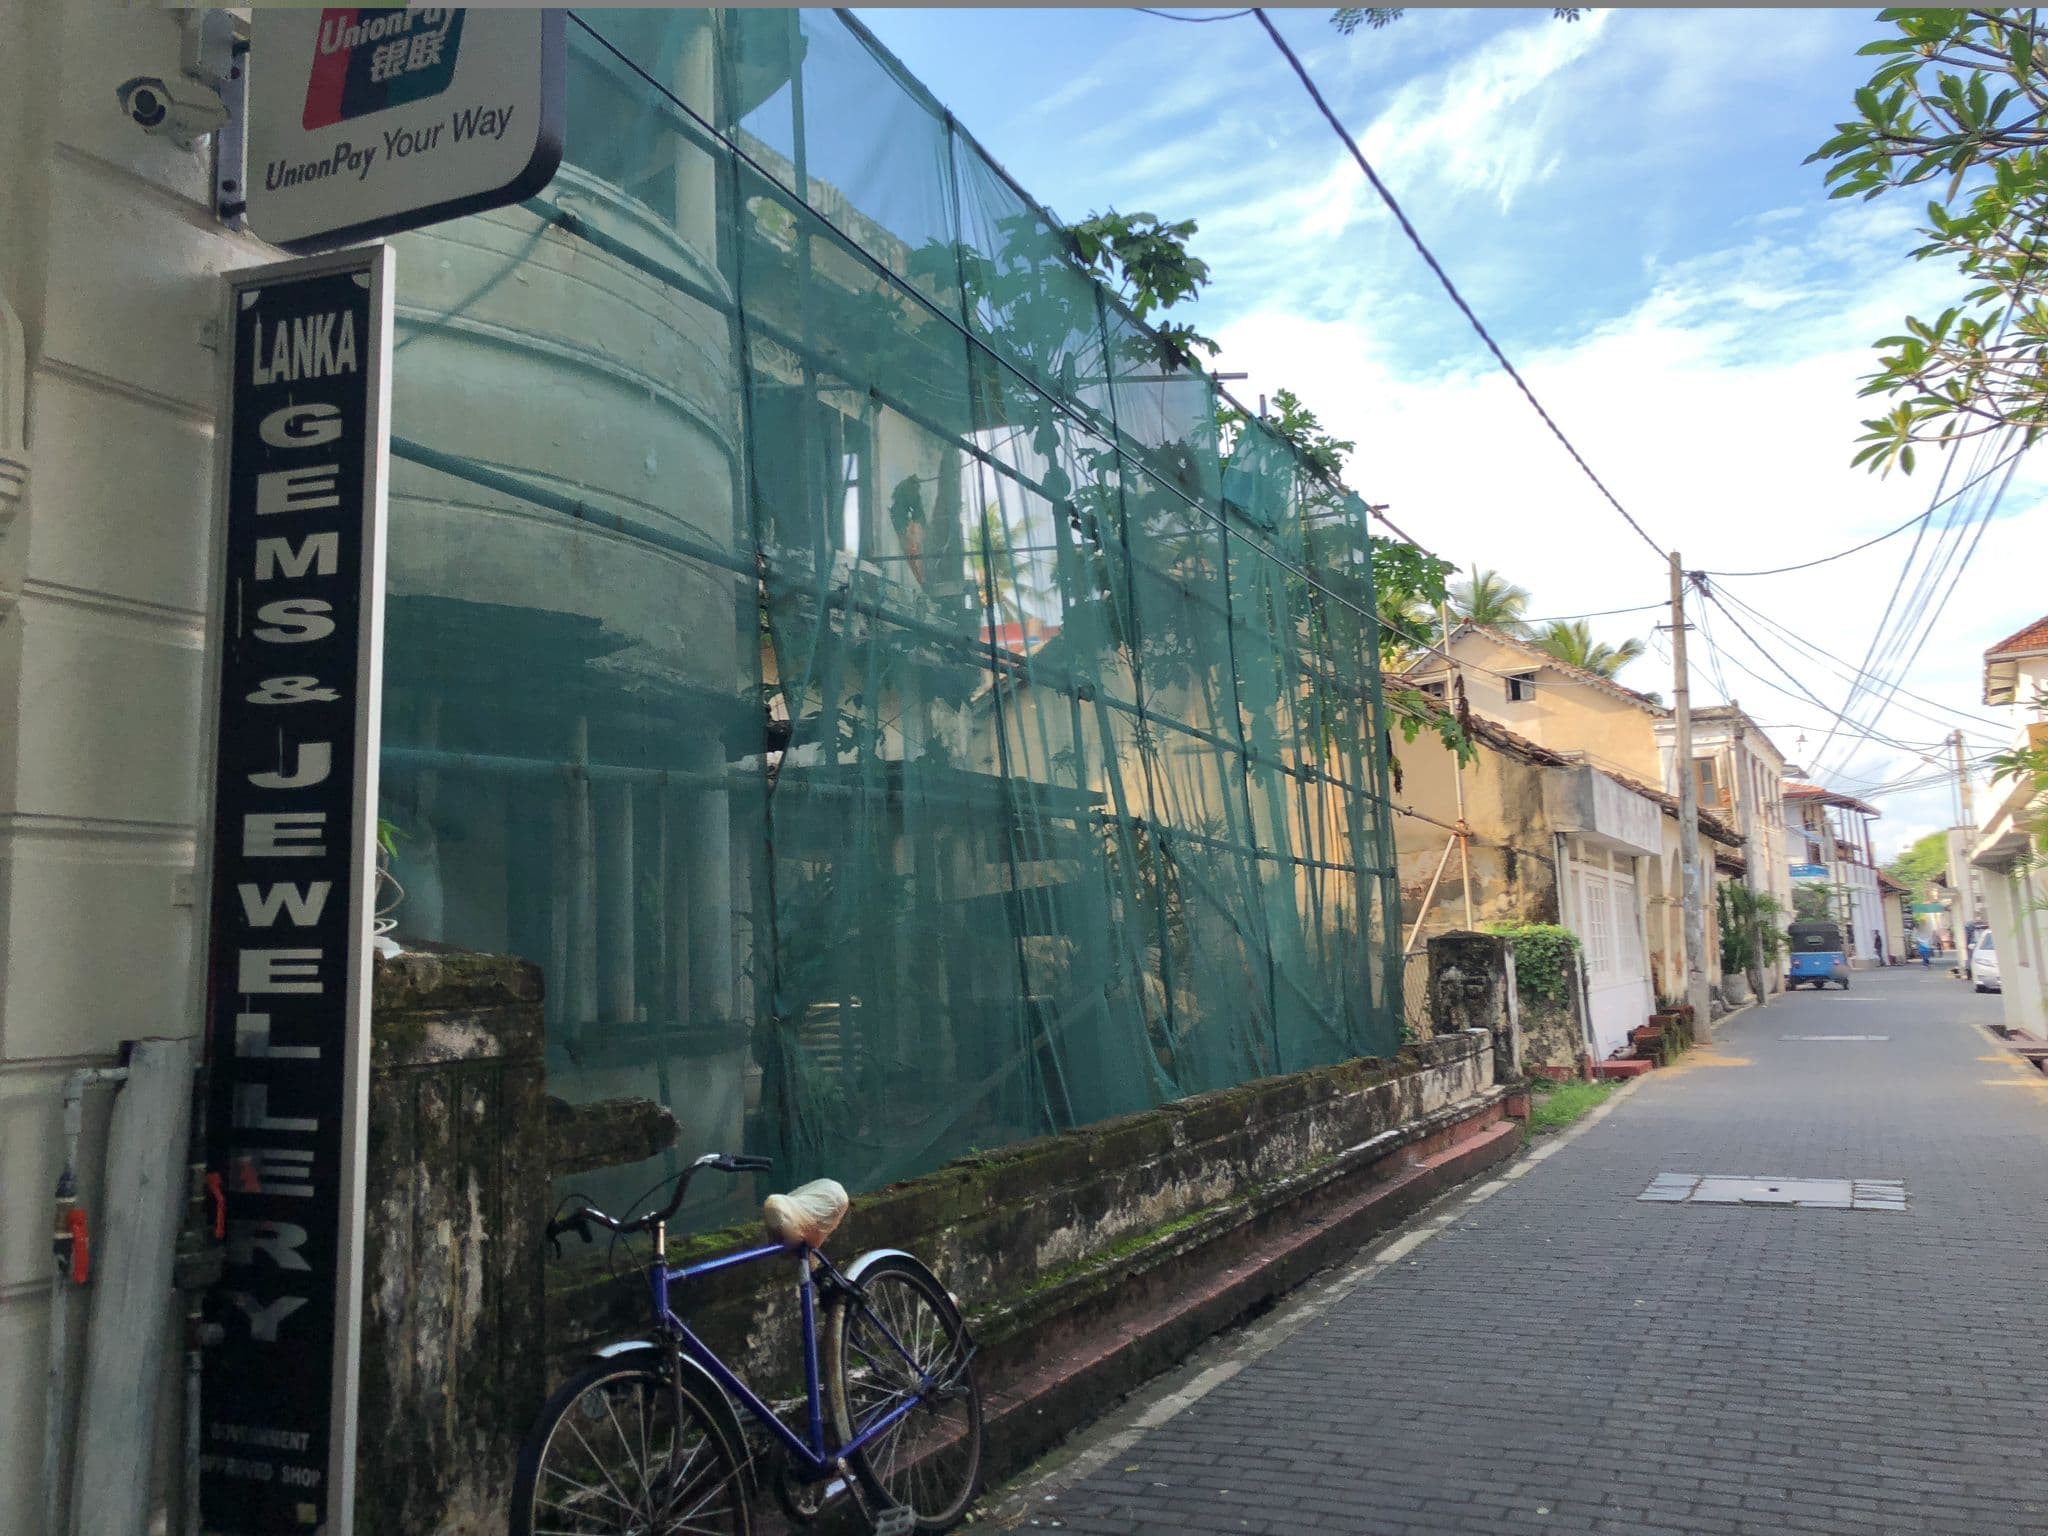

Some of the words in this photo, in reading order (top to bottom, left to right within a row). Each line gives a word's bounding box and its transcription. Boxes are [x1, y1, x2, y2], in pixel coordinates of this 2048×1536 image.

[264, 141, 376, 191] UnionPay
[383, 121, 444, 161] Your
[451, 104, 514, 143] Way
[252, 309, 357, 386] LANKA
[253, 402, 343, 644] GEMS
[245, 676, 343, 704] &
[226, 741, 333, 1343] JEWELLERY
